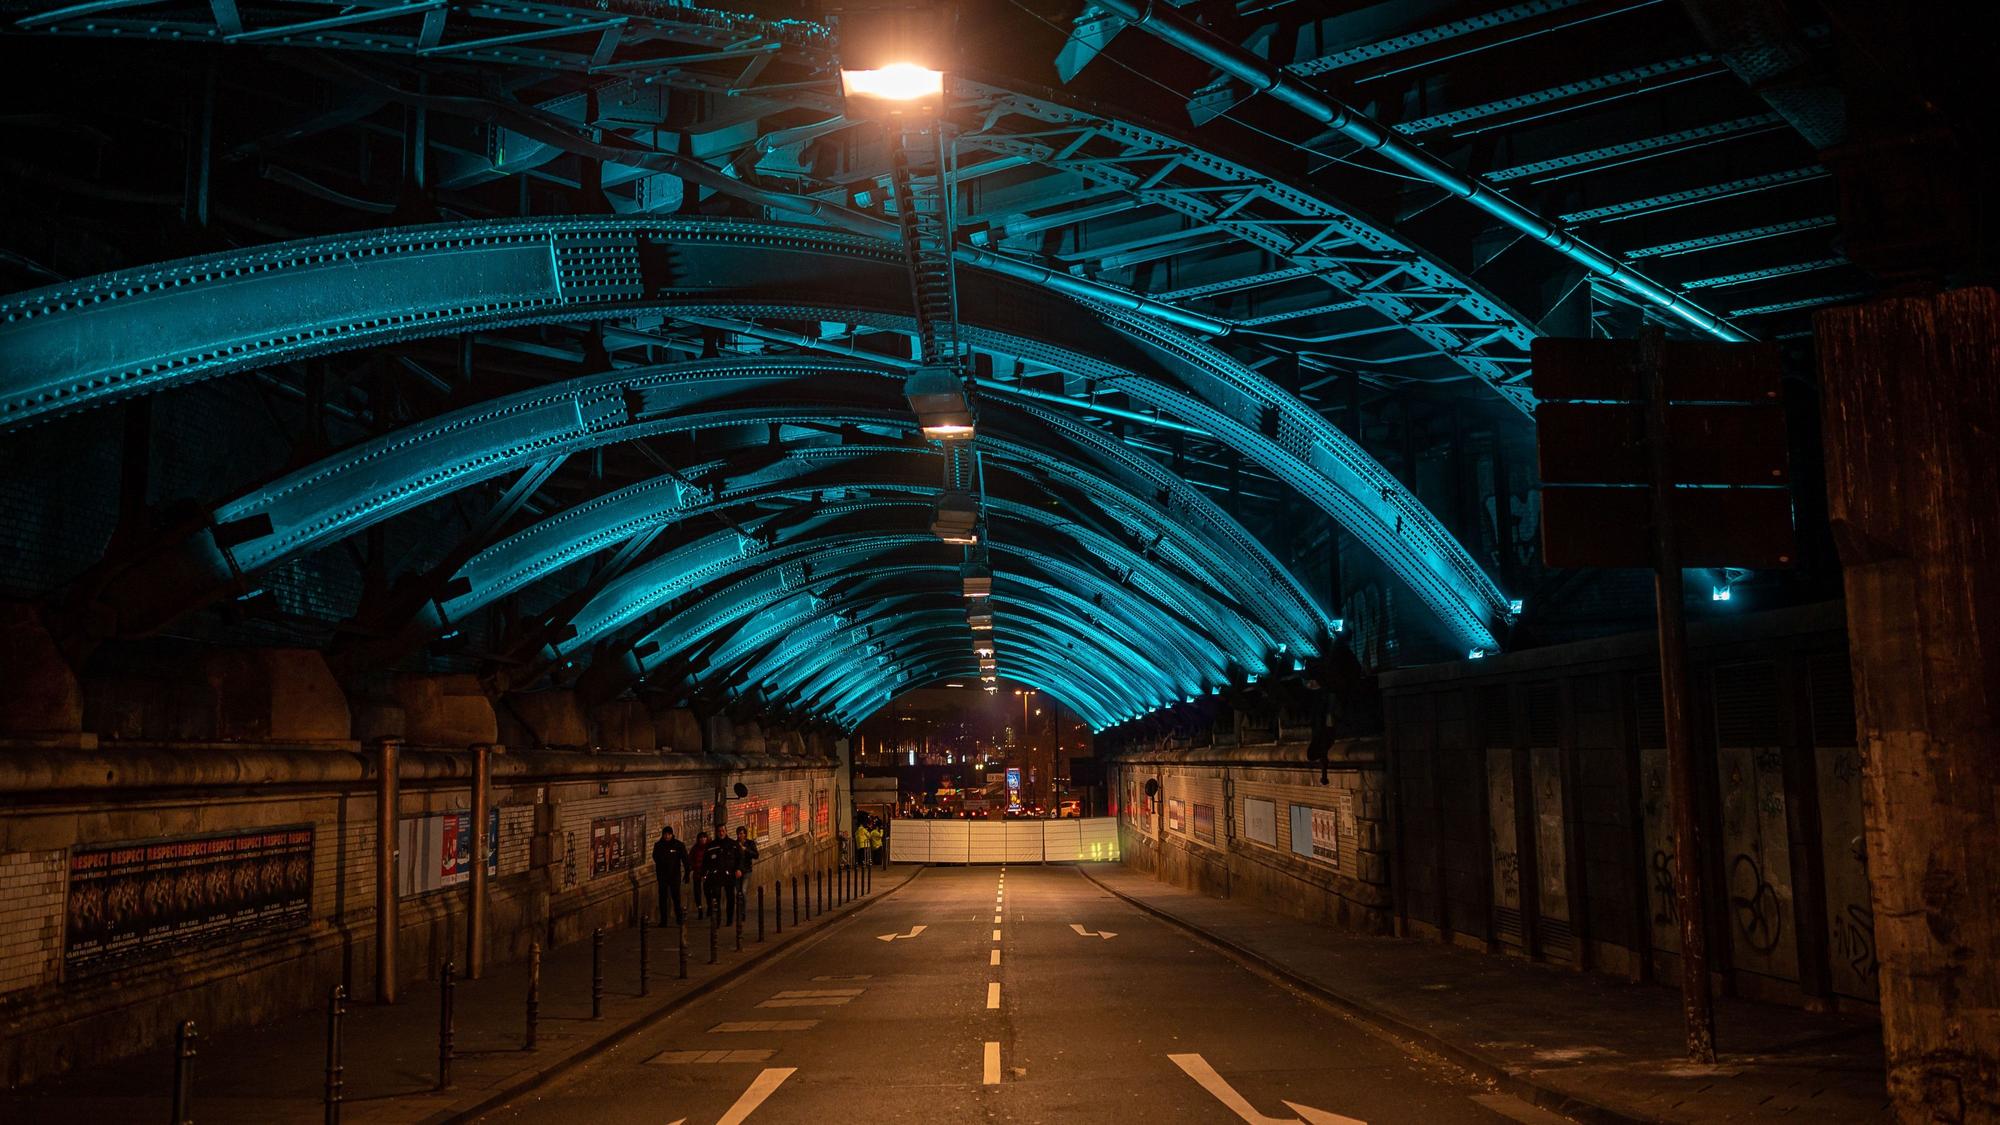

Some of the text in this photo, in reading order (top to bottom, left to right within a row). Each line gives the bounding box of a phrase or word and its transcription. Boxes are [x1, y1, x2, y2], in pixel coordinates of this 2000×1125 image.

[111, 848, 145, 864] RESPECT
[147, 845, 177, 860] RESPECT
[178, 842, 207, 857] RESPECT
[72, 853, 109, 869] RESPECT
